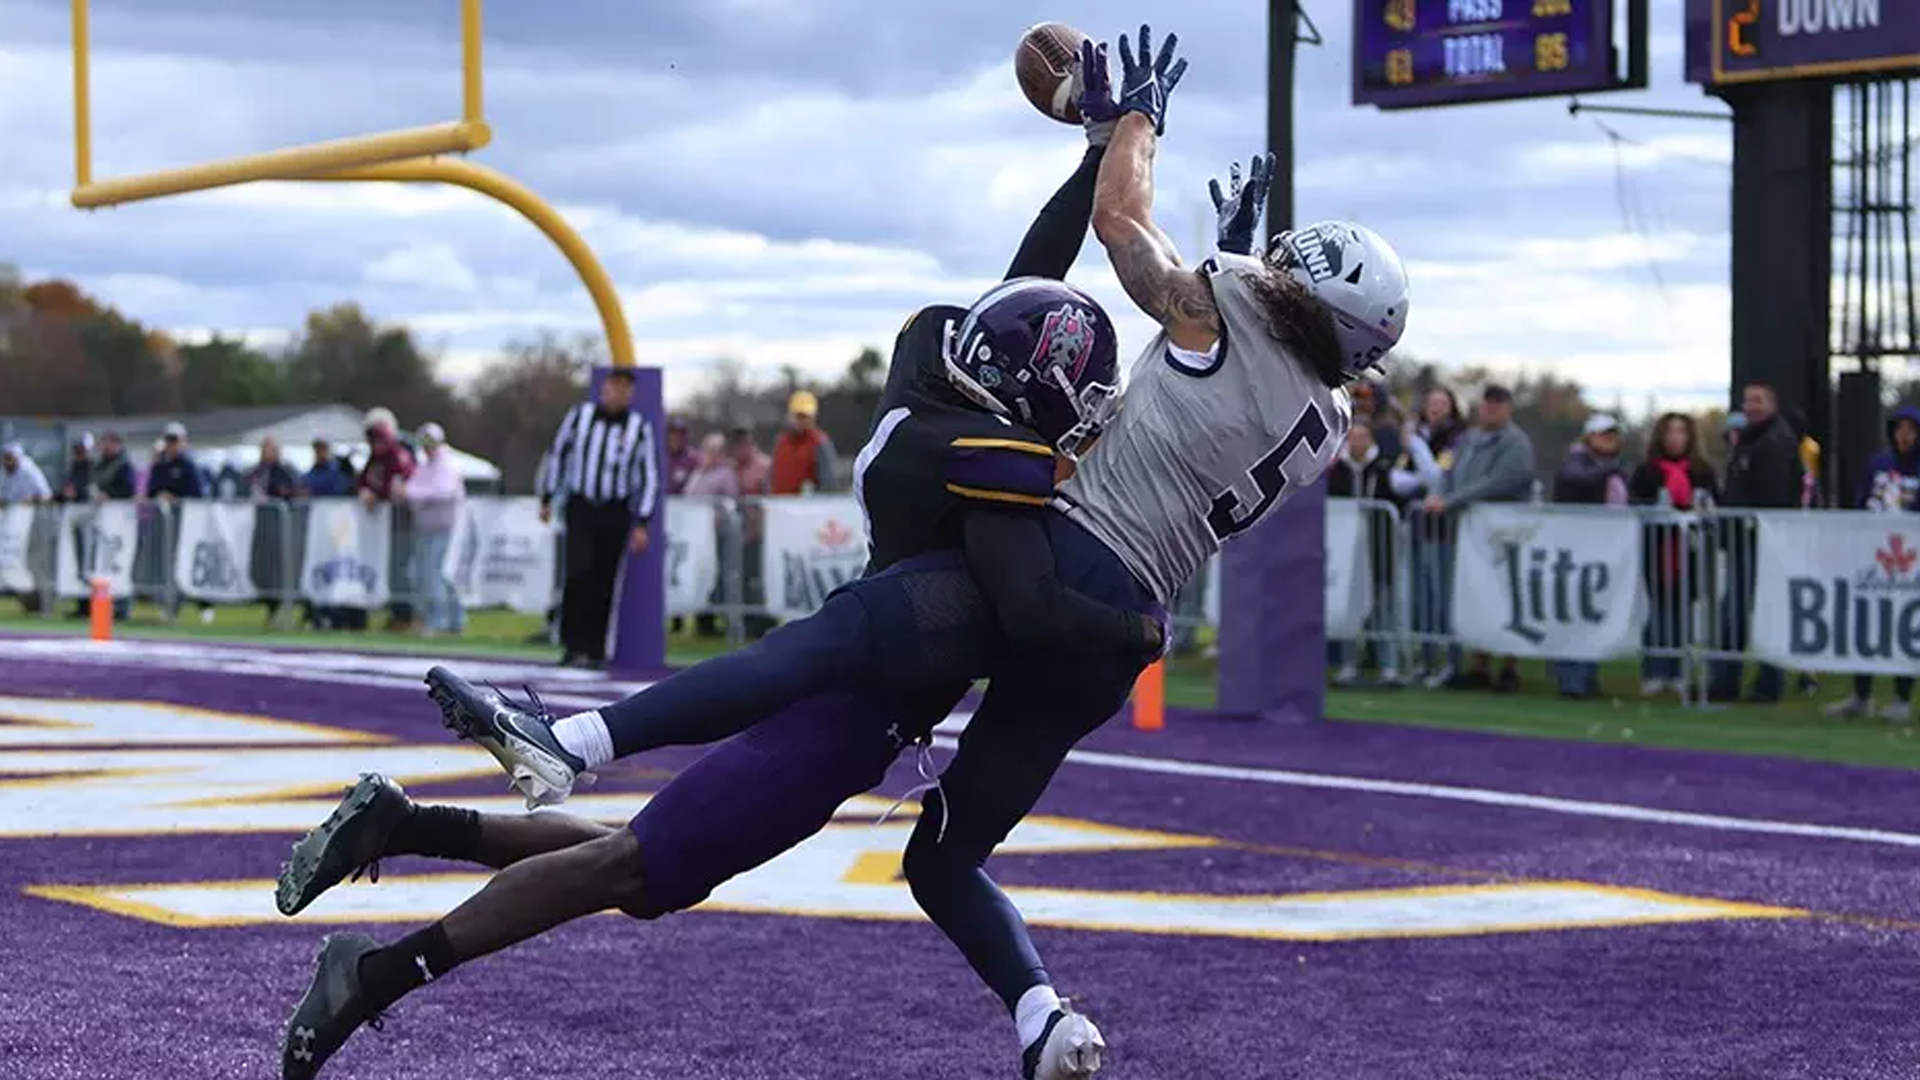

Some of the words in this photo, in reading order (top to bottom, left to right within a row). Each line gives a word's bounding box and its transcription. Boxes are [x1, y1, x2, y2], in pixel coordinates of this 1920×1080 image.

[1443, 34, 1505, 75] TOTAL
[1728, 0, 1759, 55] 2
[1778, 0, 1879, 36] DOWN
[1293, 228, 1334, 283] UNH
[1203, 396, 1332, 543] 5
[1488, 525, 1610, 645] Lite
[1788, 576, 1920, 659] Blue
